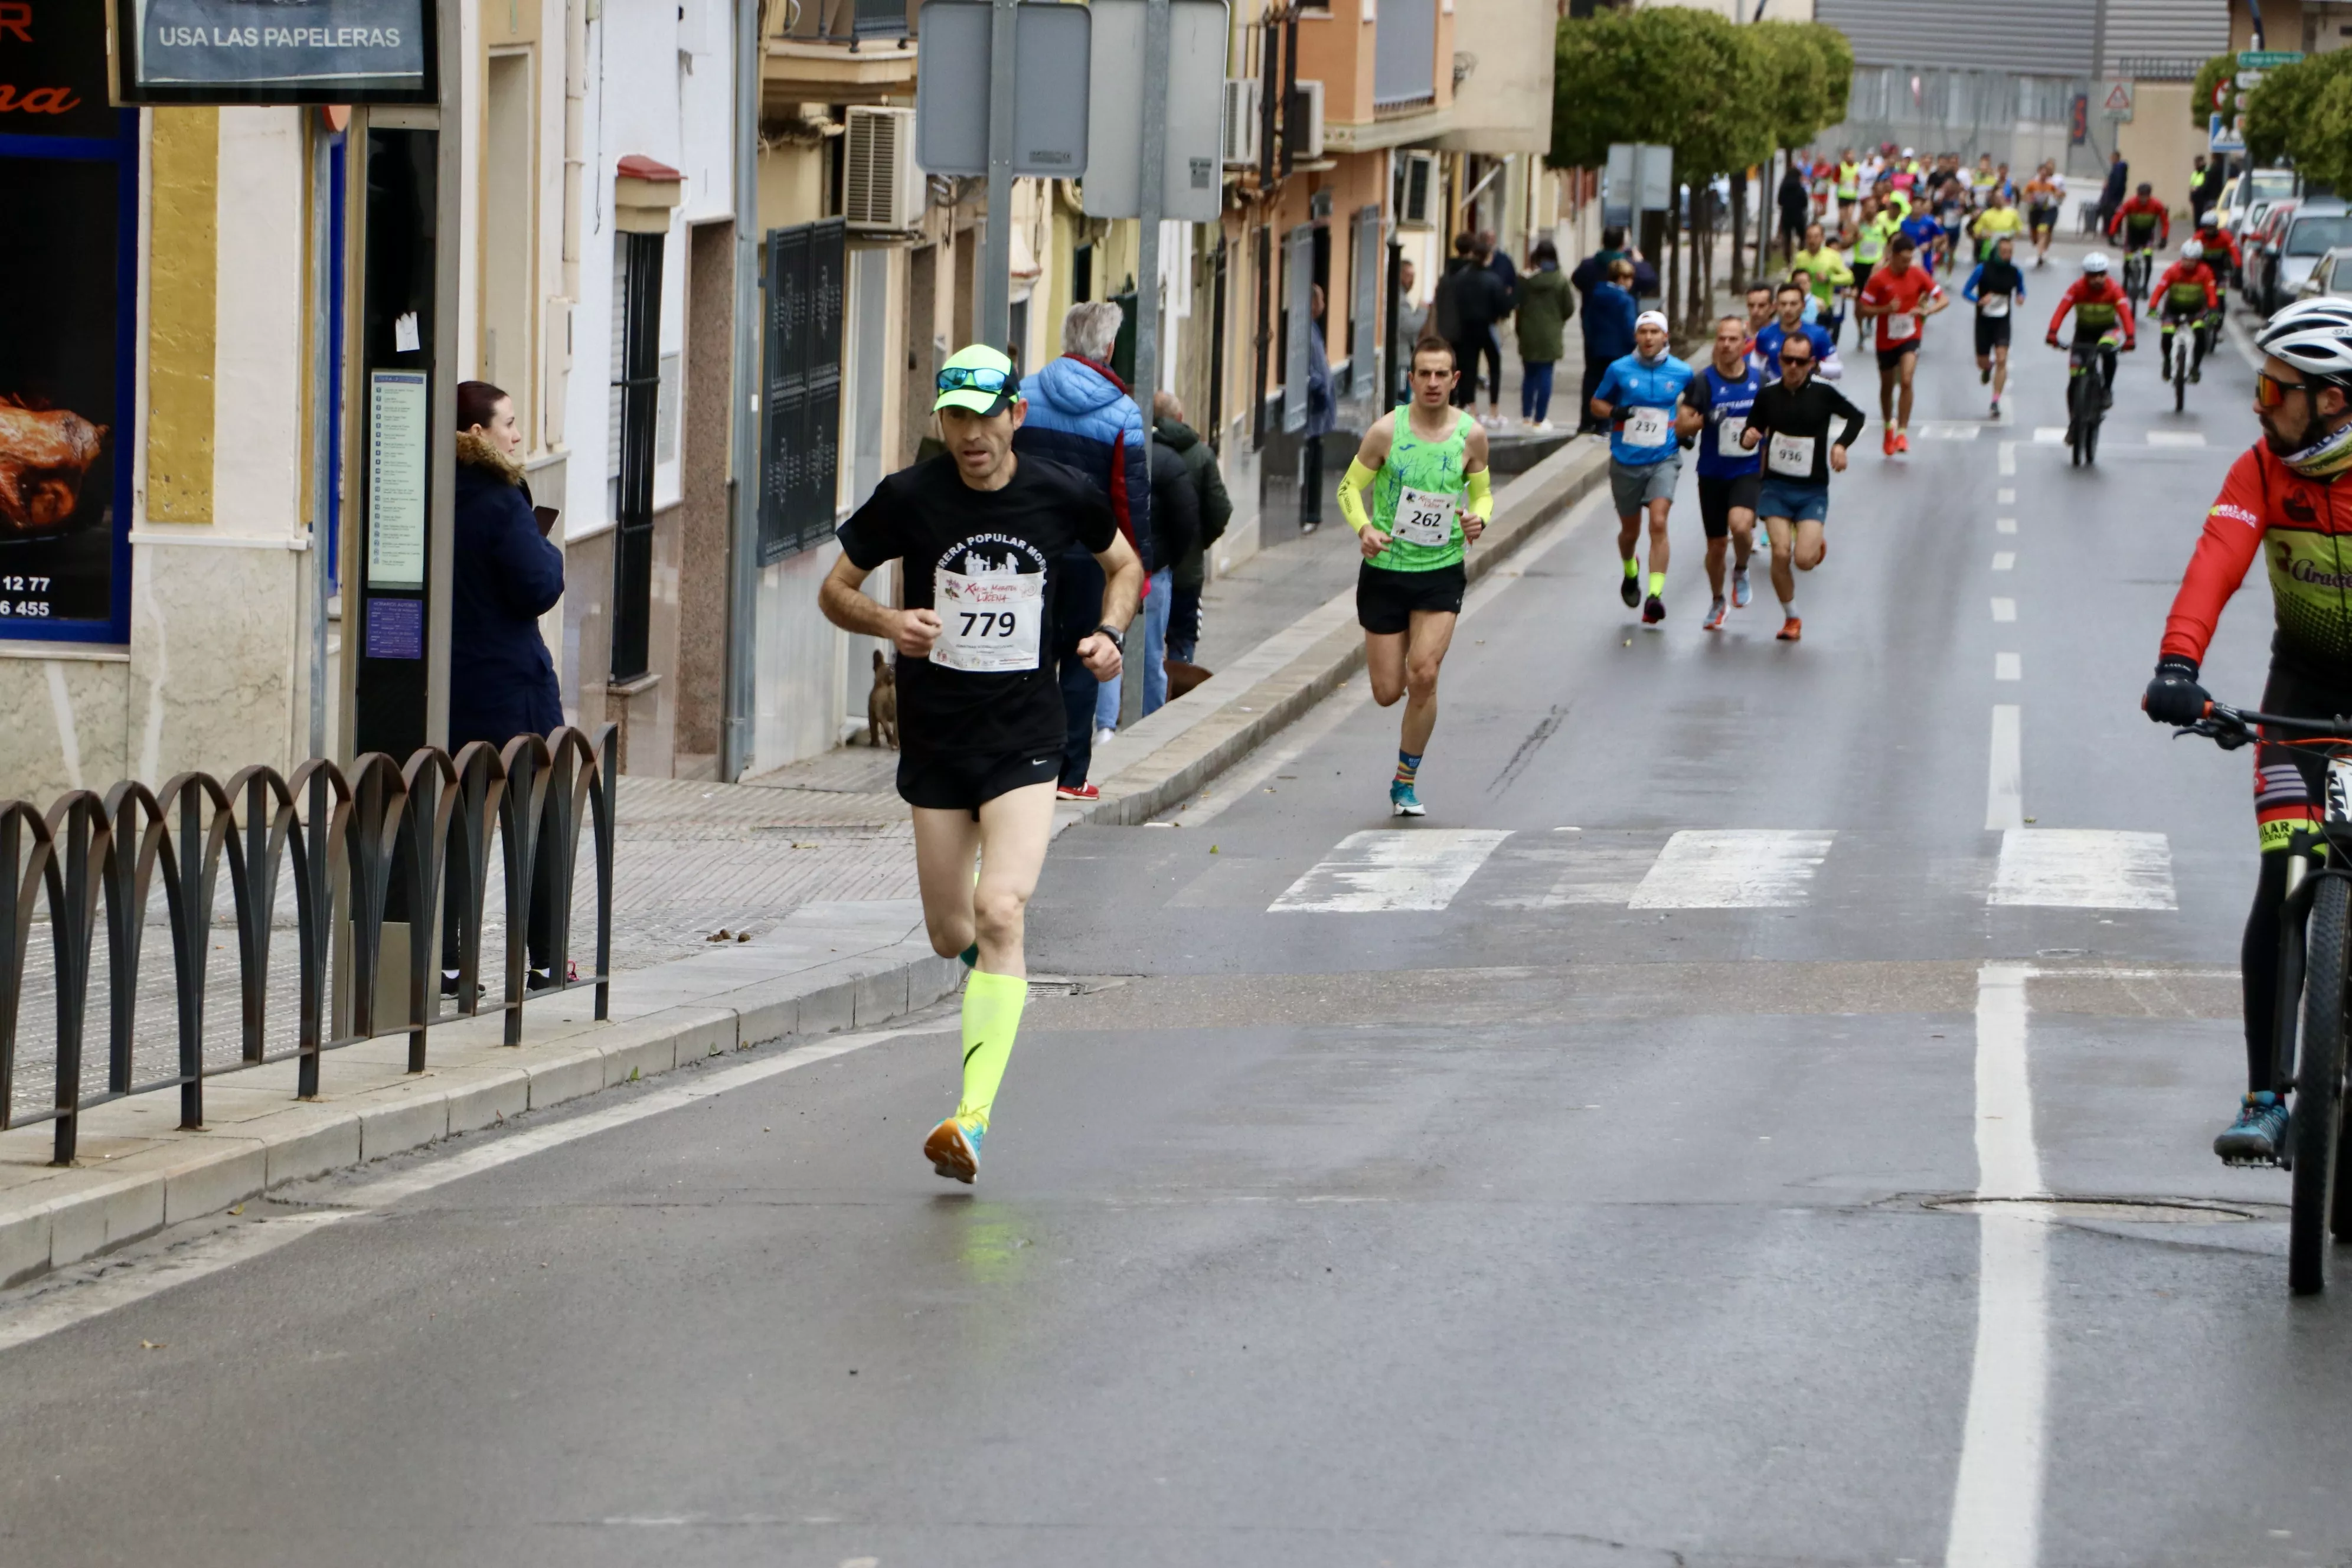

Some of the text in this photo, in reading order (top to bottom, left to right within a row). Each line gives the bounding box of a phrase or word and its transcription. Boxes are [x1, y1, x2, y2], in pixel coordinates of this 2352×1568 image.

[159, 28, 401, 47] USA LAS PAPELERAS
[1635, 420, 1658, 433] 237
[1779, 449, 1802, 462] 936
[1411, 510, 1442, 527] 262
[935, 542, 966, 569] RERA
[966, 533, 1027, 550] POPULAR
[3, 576, 50, 592] 12 77
[976, 593, 1010, 603] LUCENA
[0, 600, 50, 616] 6 455
[960, 612, 1016, 638] 779
[2259, 821, 2289, 838] ILAR
